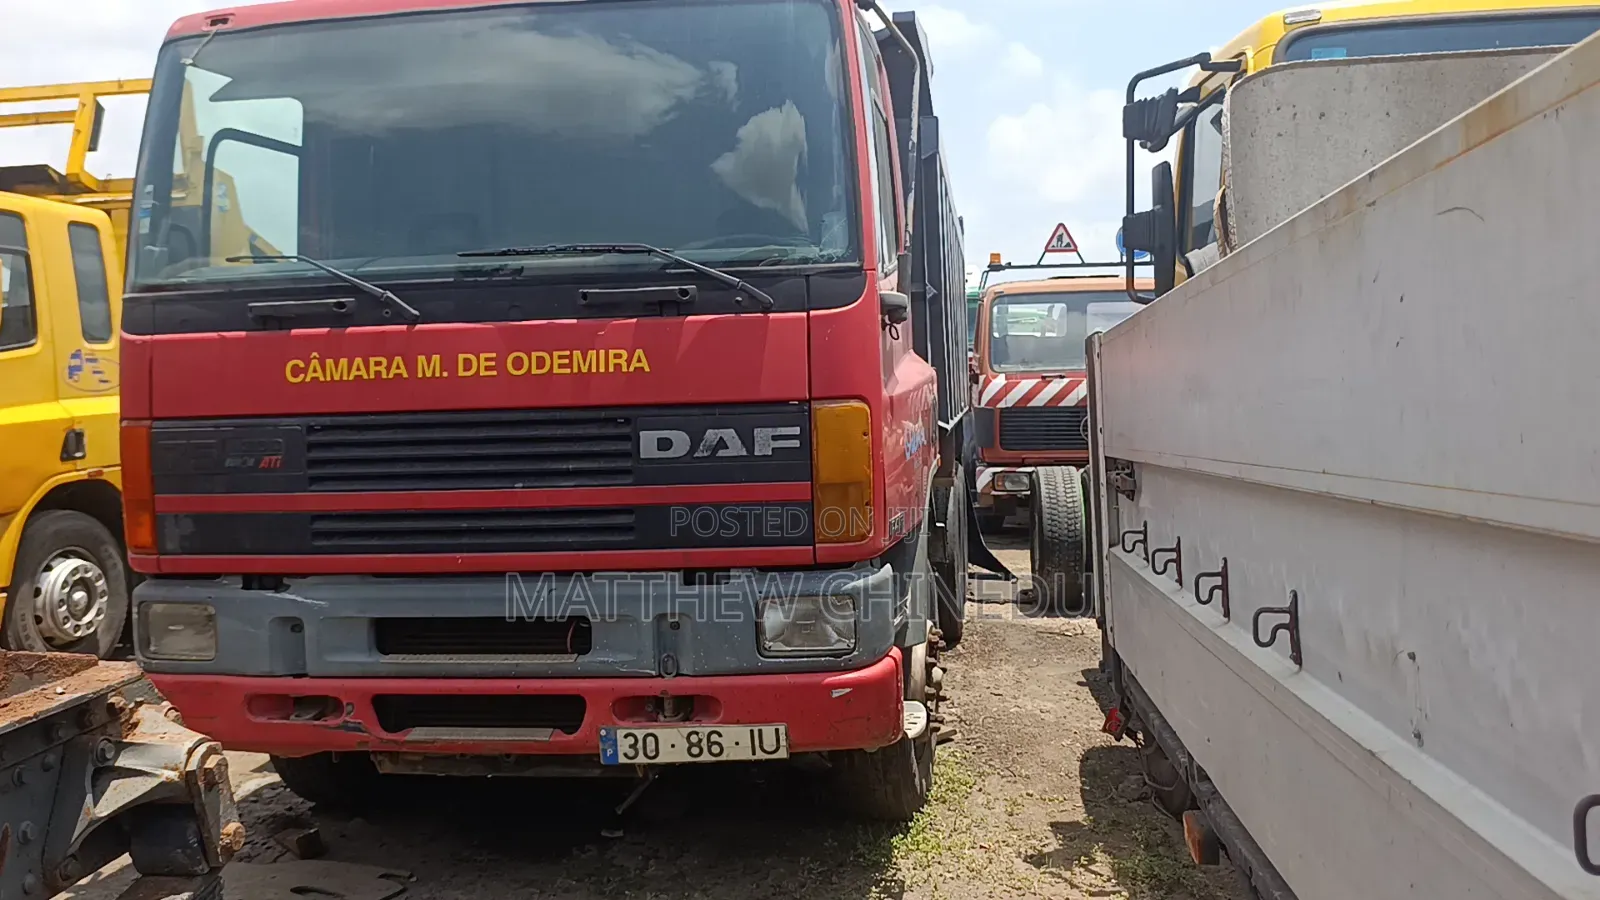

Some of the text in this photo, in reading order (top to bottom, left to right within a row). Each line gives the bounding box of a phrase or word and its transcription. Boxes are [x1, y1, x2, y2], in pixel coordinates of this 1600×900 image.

[285, 348, 650, 383] CÂMARA M. DE ODEMIRA
[639, 426, 800, 459] DAF
